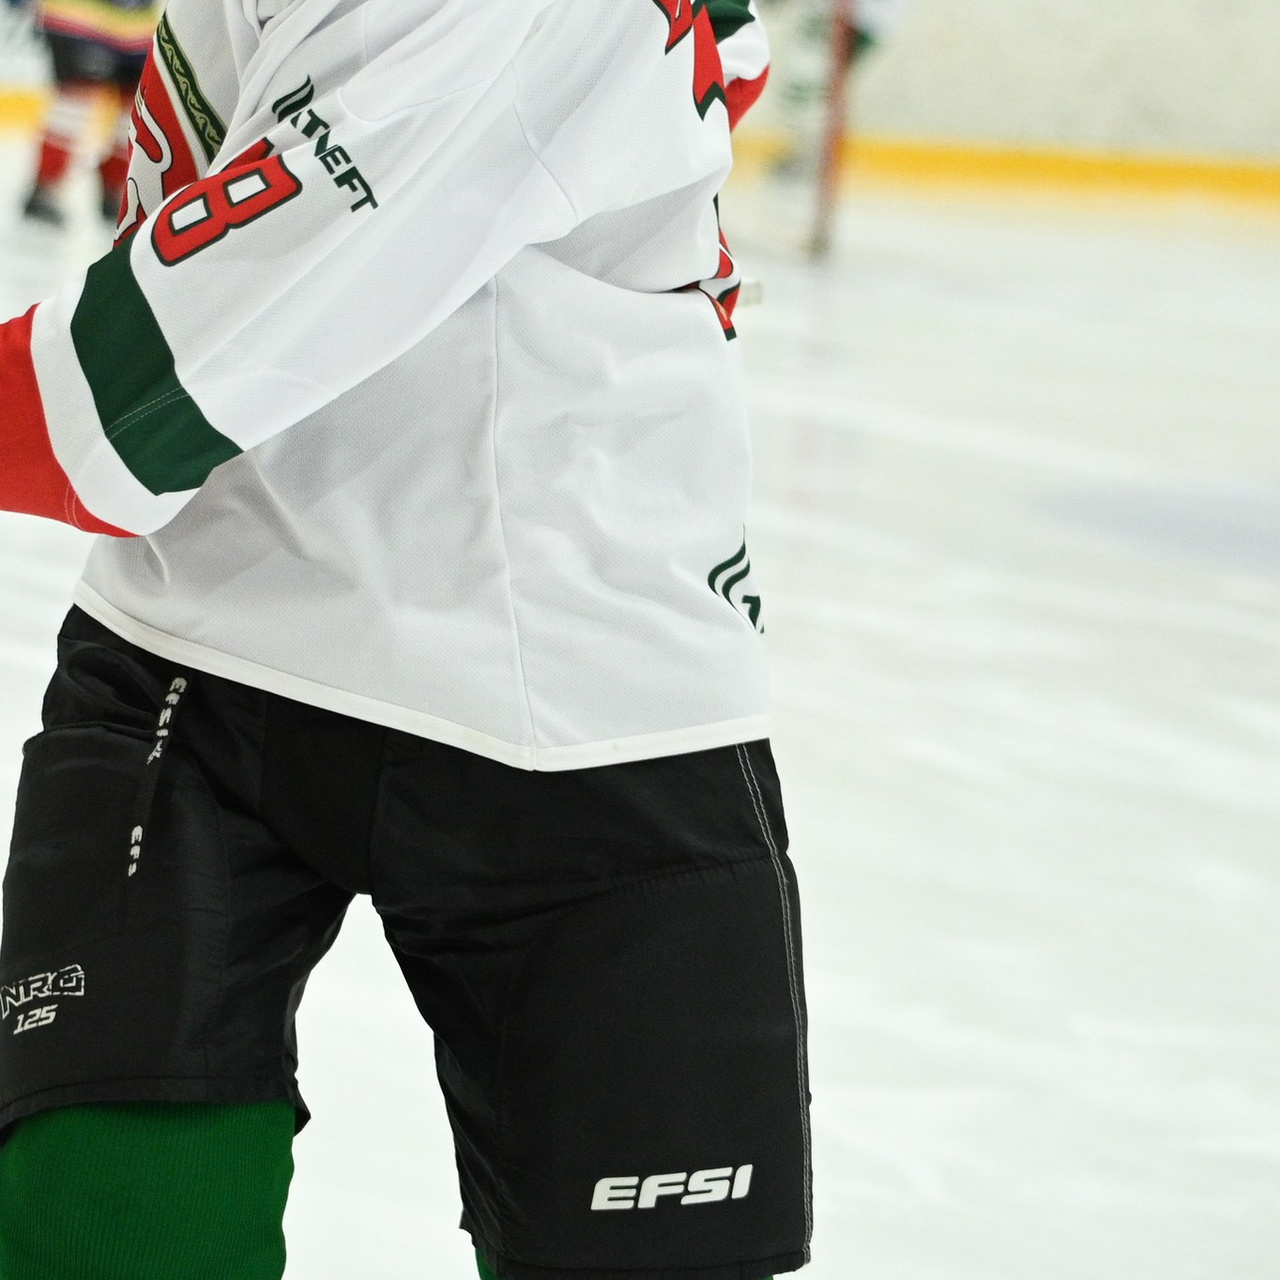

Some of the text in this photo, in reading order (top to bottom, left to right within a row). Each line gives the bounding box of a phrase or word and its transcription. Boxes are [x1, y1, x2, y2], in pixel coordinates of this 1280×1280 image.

[0, 964, 84, 1019] NRG
[14, 1004, 58, 1035] 125
[591, 1163, 753, 1210] EFSI
